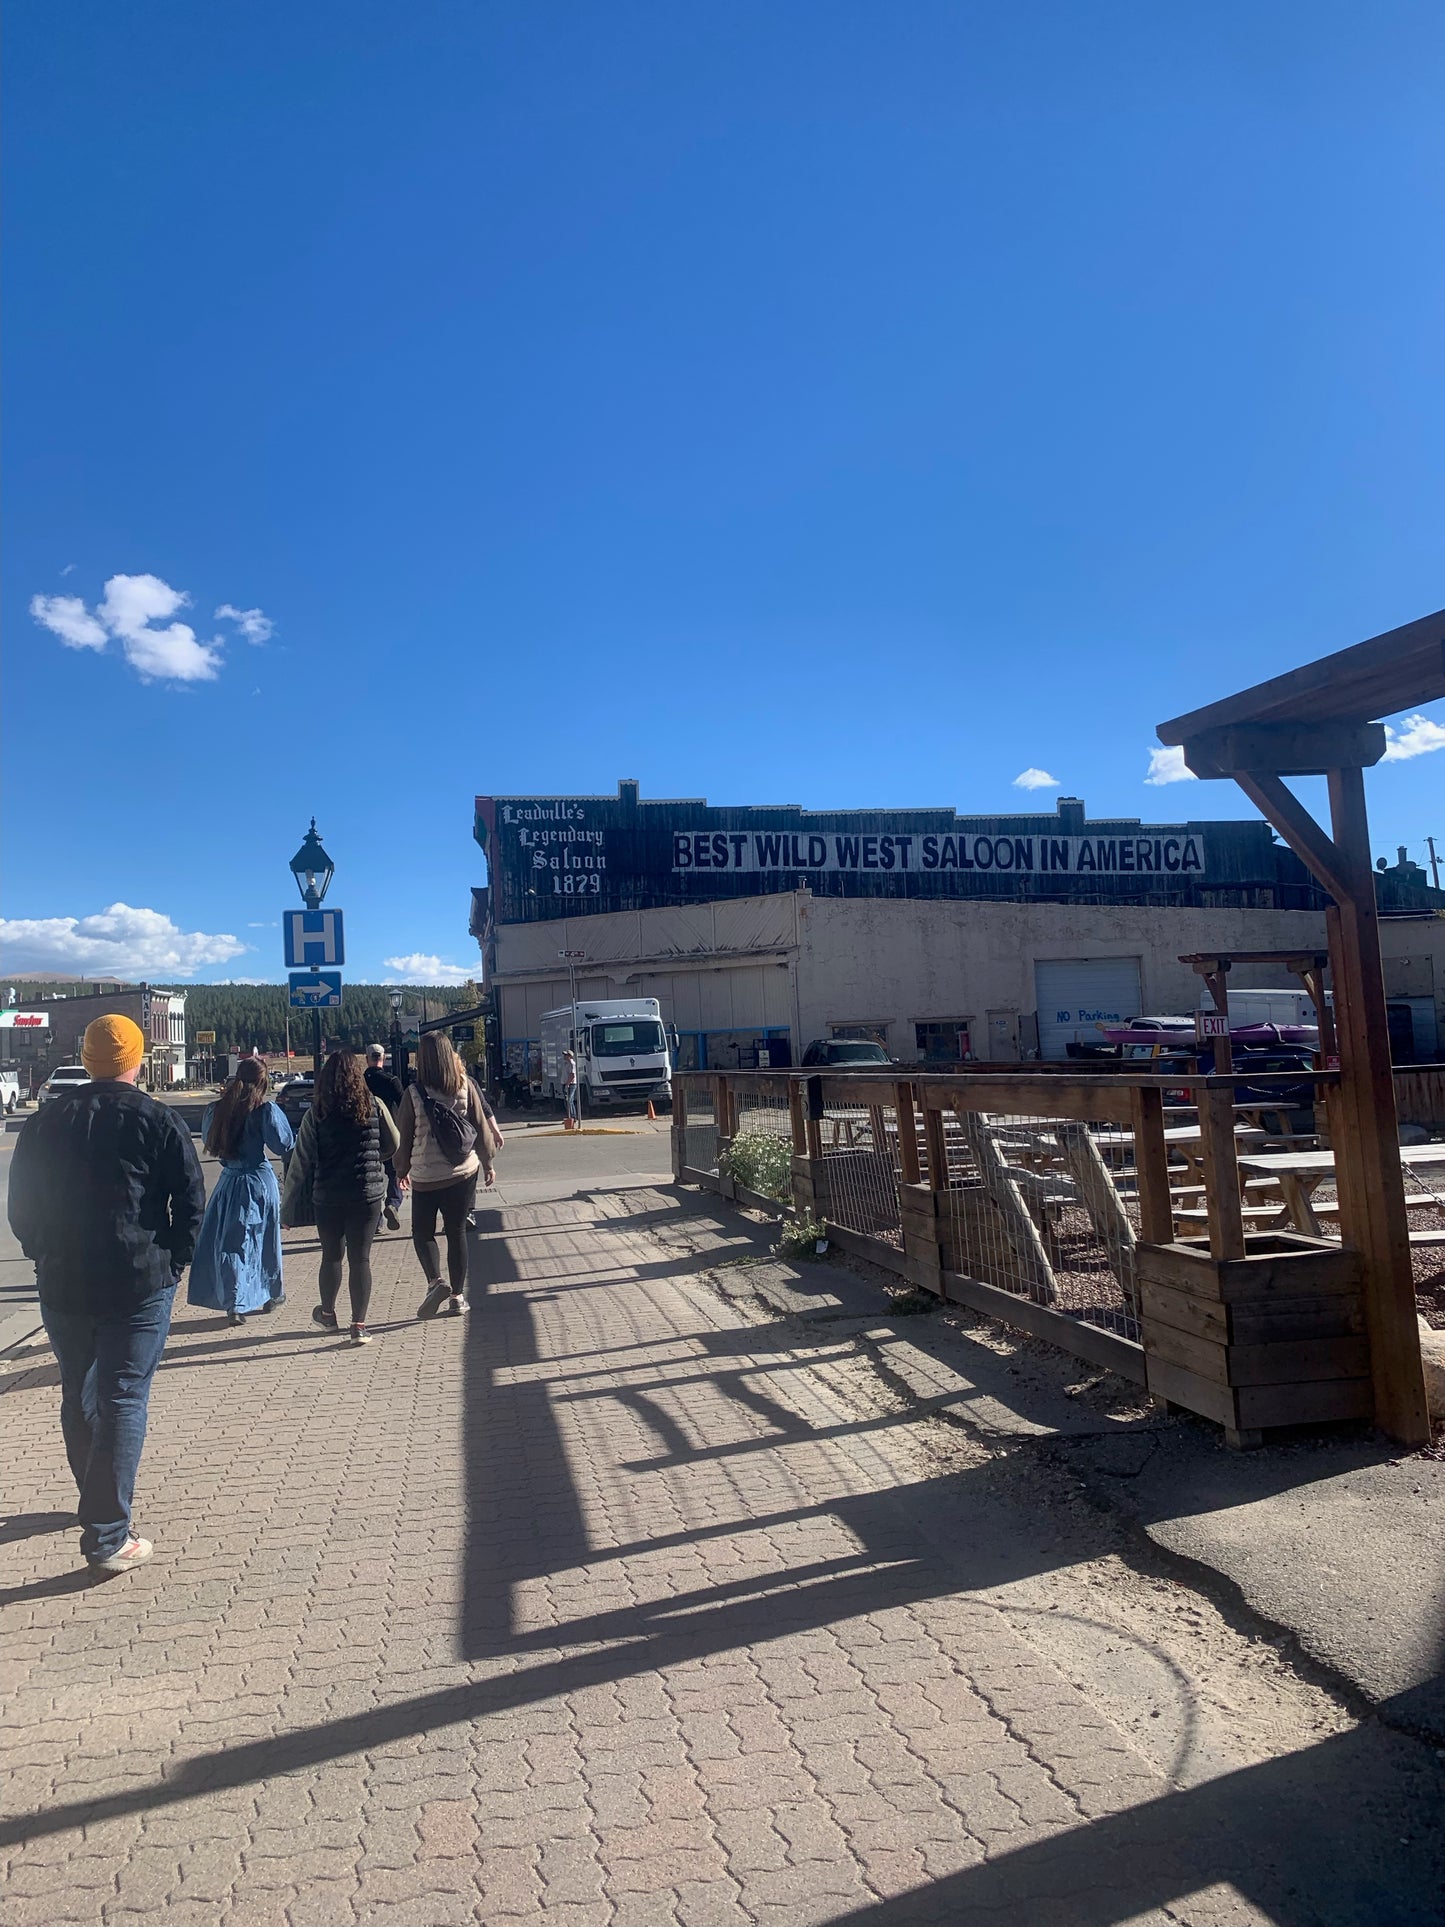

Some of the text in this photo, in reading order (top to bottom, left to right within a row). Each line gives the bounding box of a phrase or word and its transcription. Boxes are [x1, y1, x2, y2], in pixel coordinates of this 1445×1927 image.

[502, 802, 585, 824] Leadville's
[518, 825, 604, 847] Legendary
[531, 847, 606, 870] Saloon
[674, 834, 1202, 871] BEST WILD WEST SALOON IN AMERICA
[553, 873, 600, 894] 1879
[292, 913, 336, 963] H
[142, 993, 150, 1028] CAFE
[1078, 1009, 1120, 1023] Parking
[1203, 1018, 1226, 1034] EXIT
